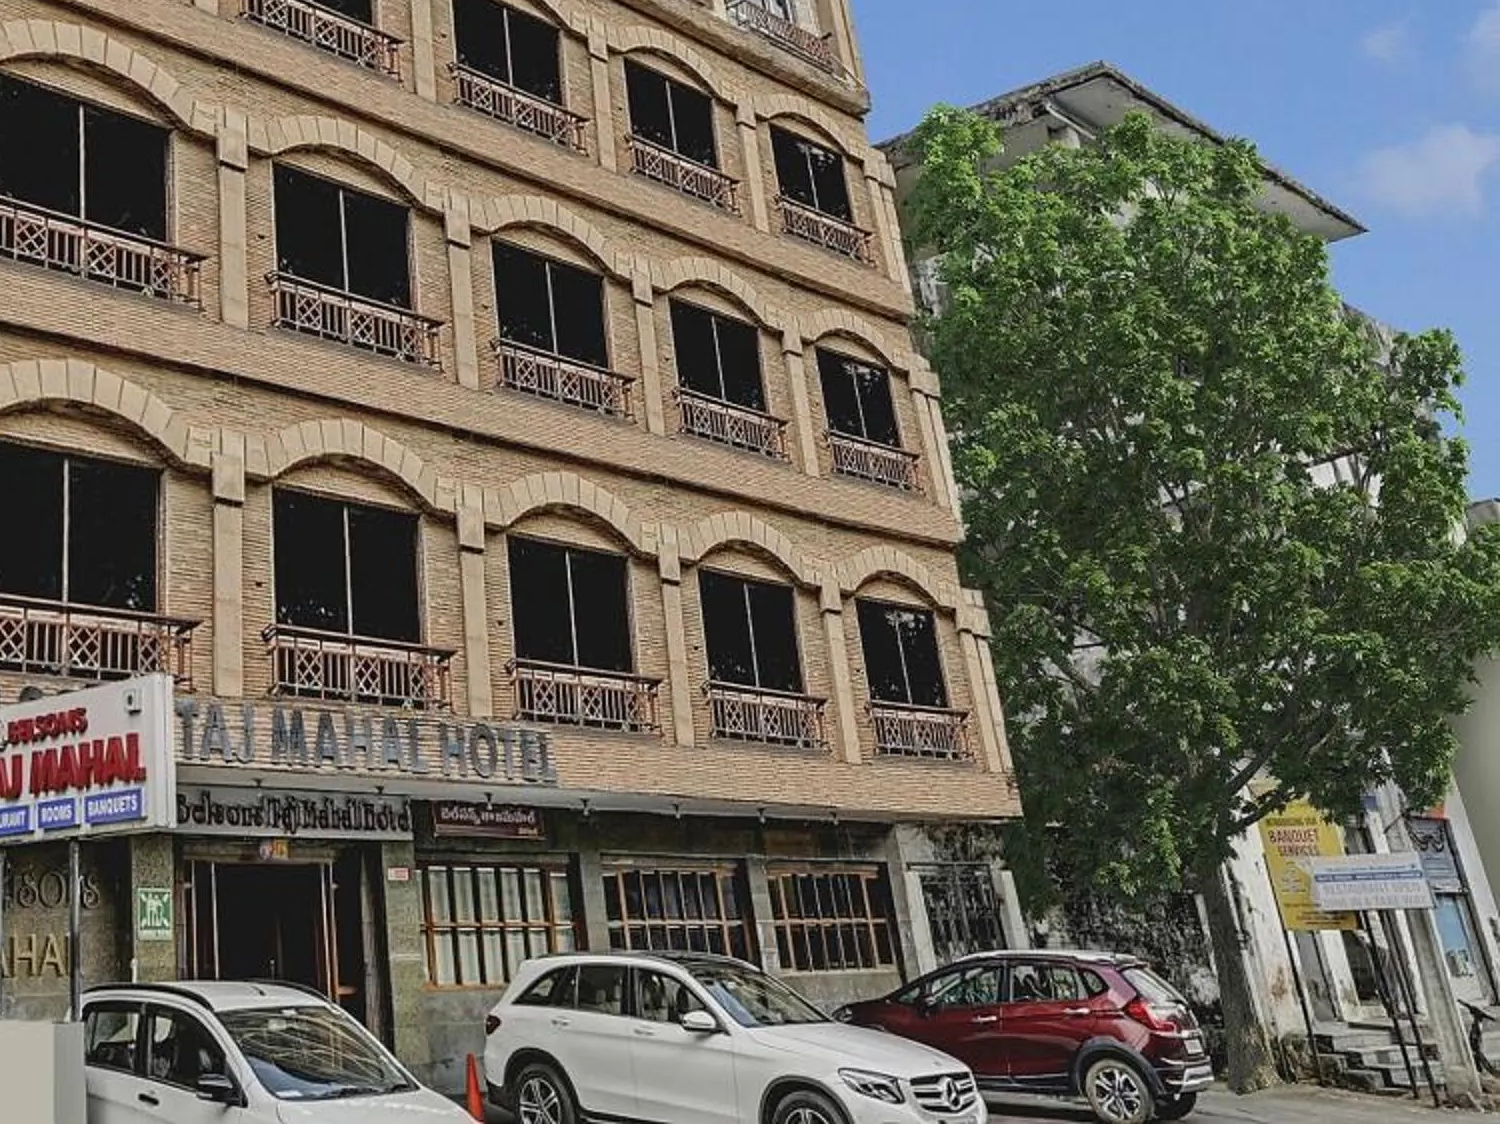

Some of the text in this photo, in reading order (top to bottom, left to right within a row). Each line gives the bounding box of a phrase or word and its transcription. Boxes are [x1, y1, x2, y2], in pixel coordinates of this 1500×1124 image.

[176, 698, 558, 783] TAJ MAHAL HOTEL
[30, 732, 147, 798] MAHAL
[41, 803, 73, 823] ROOMS
[87, 794, 138, 818] BANQUETS
[1268, 827, 1318, 845] BANQUET
